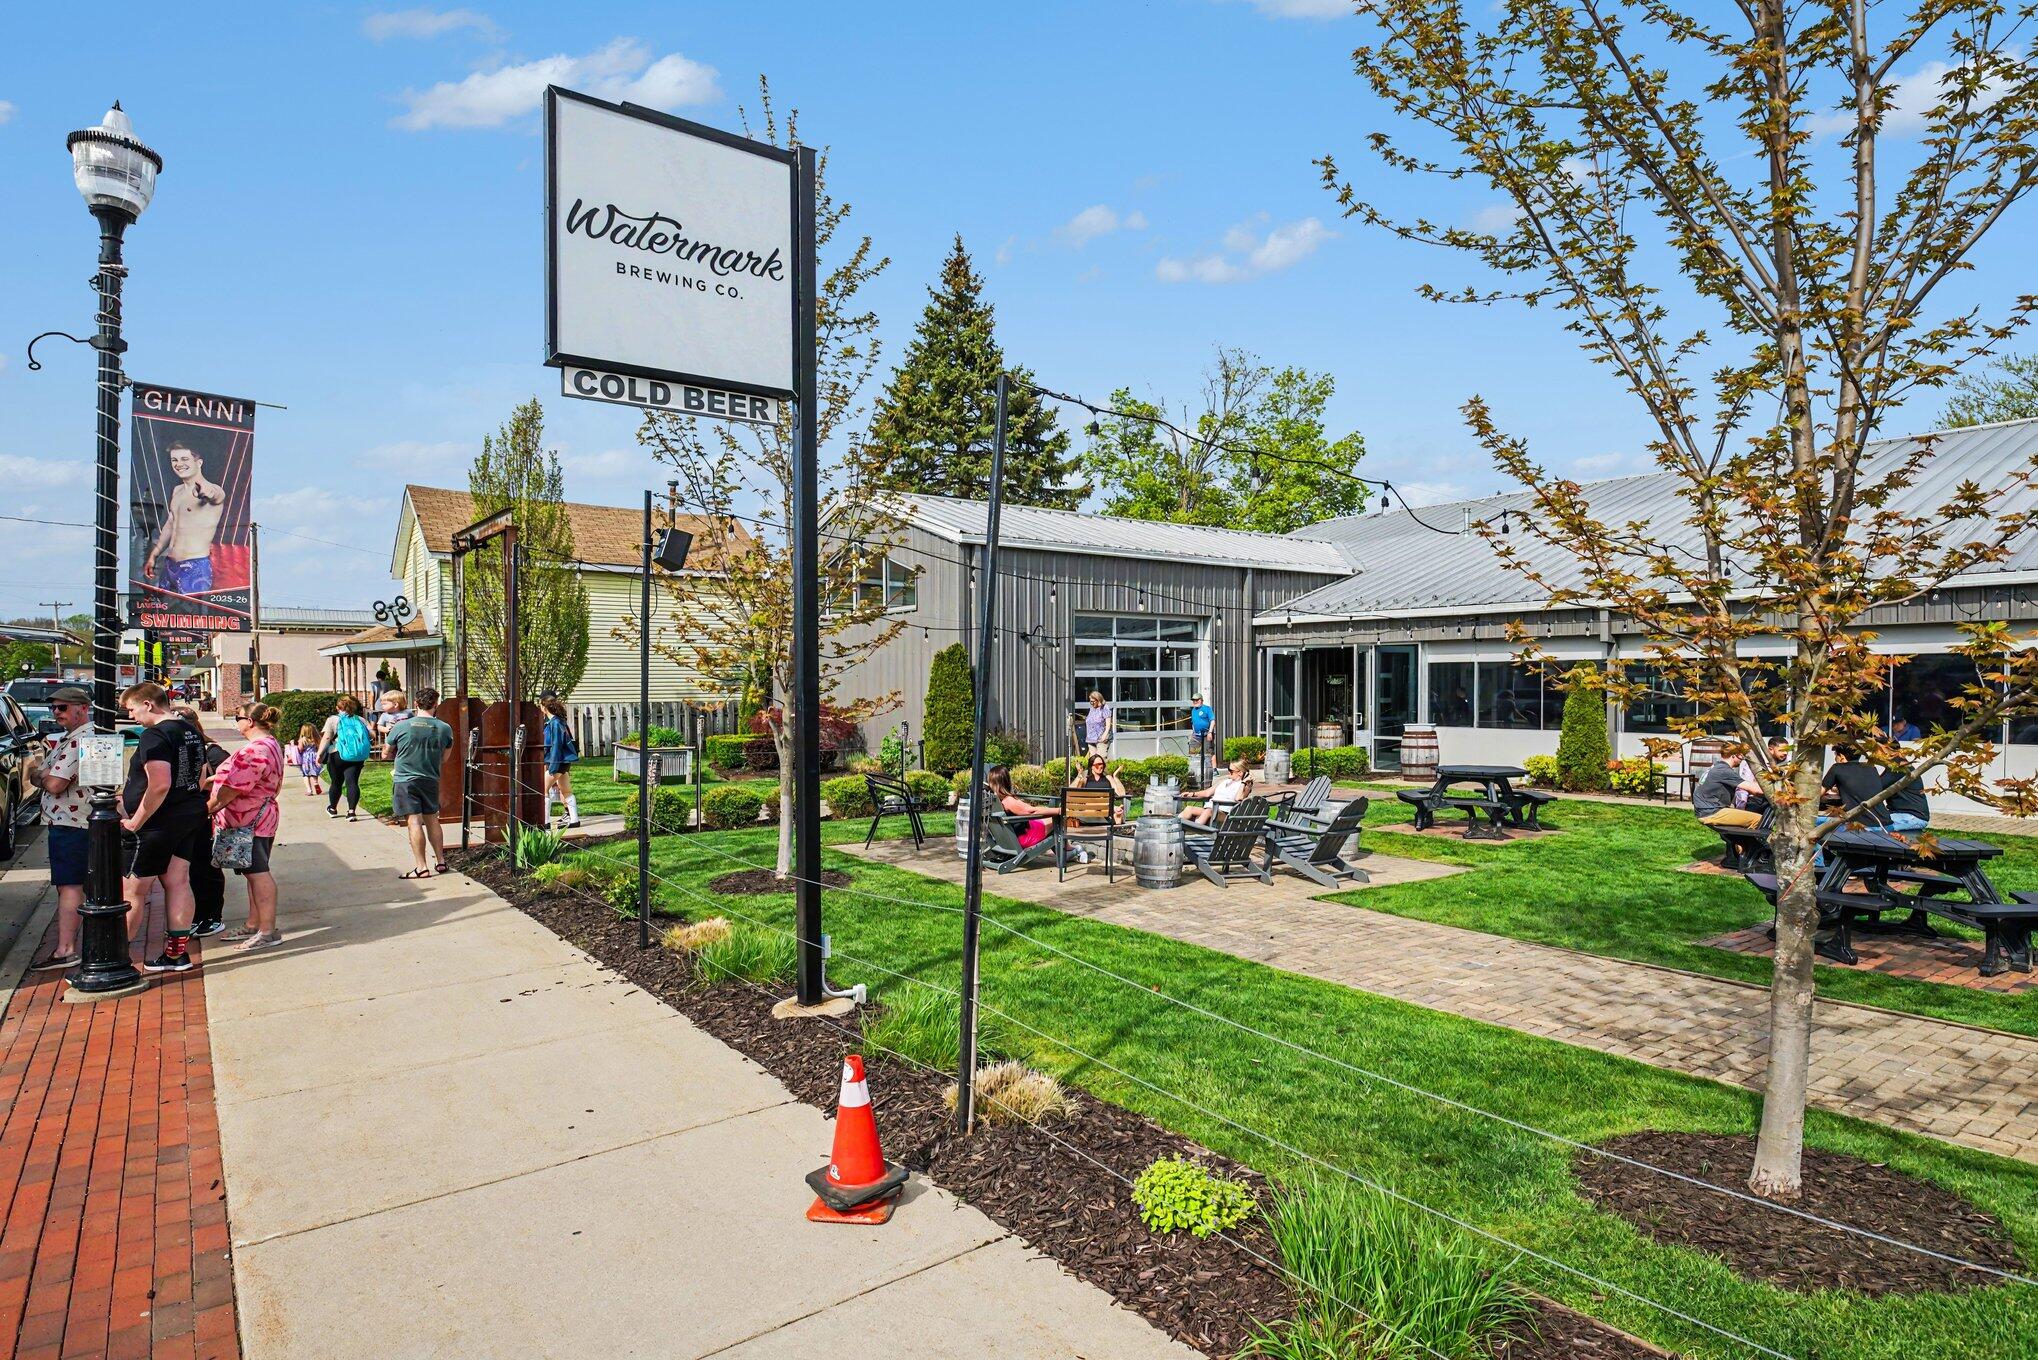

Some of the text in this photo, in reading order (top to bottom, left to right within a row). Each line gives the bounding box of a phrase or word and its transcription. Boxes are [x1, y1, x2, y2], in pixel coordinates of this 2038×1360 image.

[565, 198, 785, 282] Watermark
[616, 261, 744, 300] BREWING CO.
[144, 390, 243, 423] GIANNI
[573, 370, 770, 421] COLD BEER
[210, 595, 248, 604] 2025-26
[140, 613, 240, 630] SWIMMING
